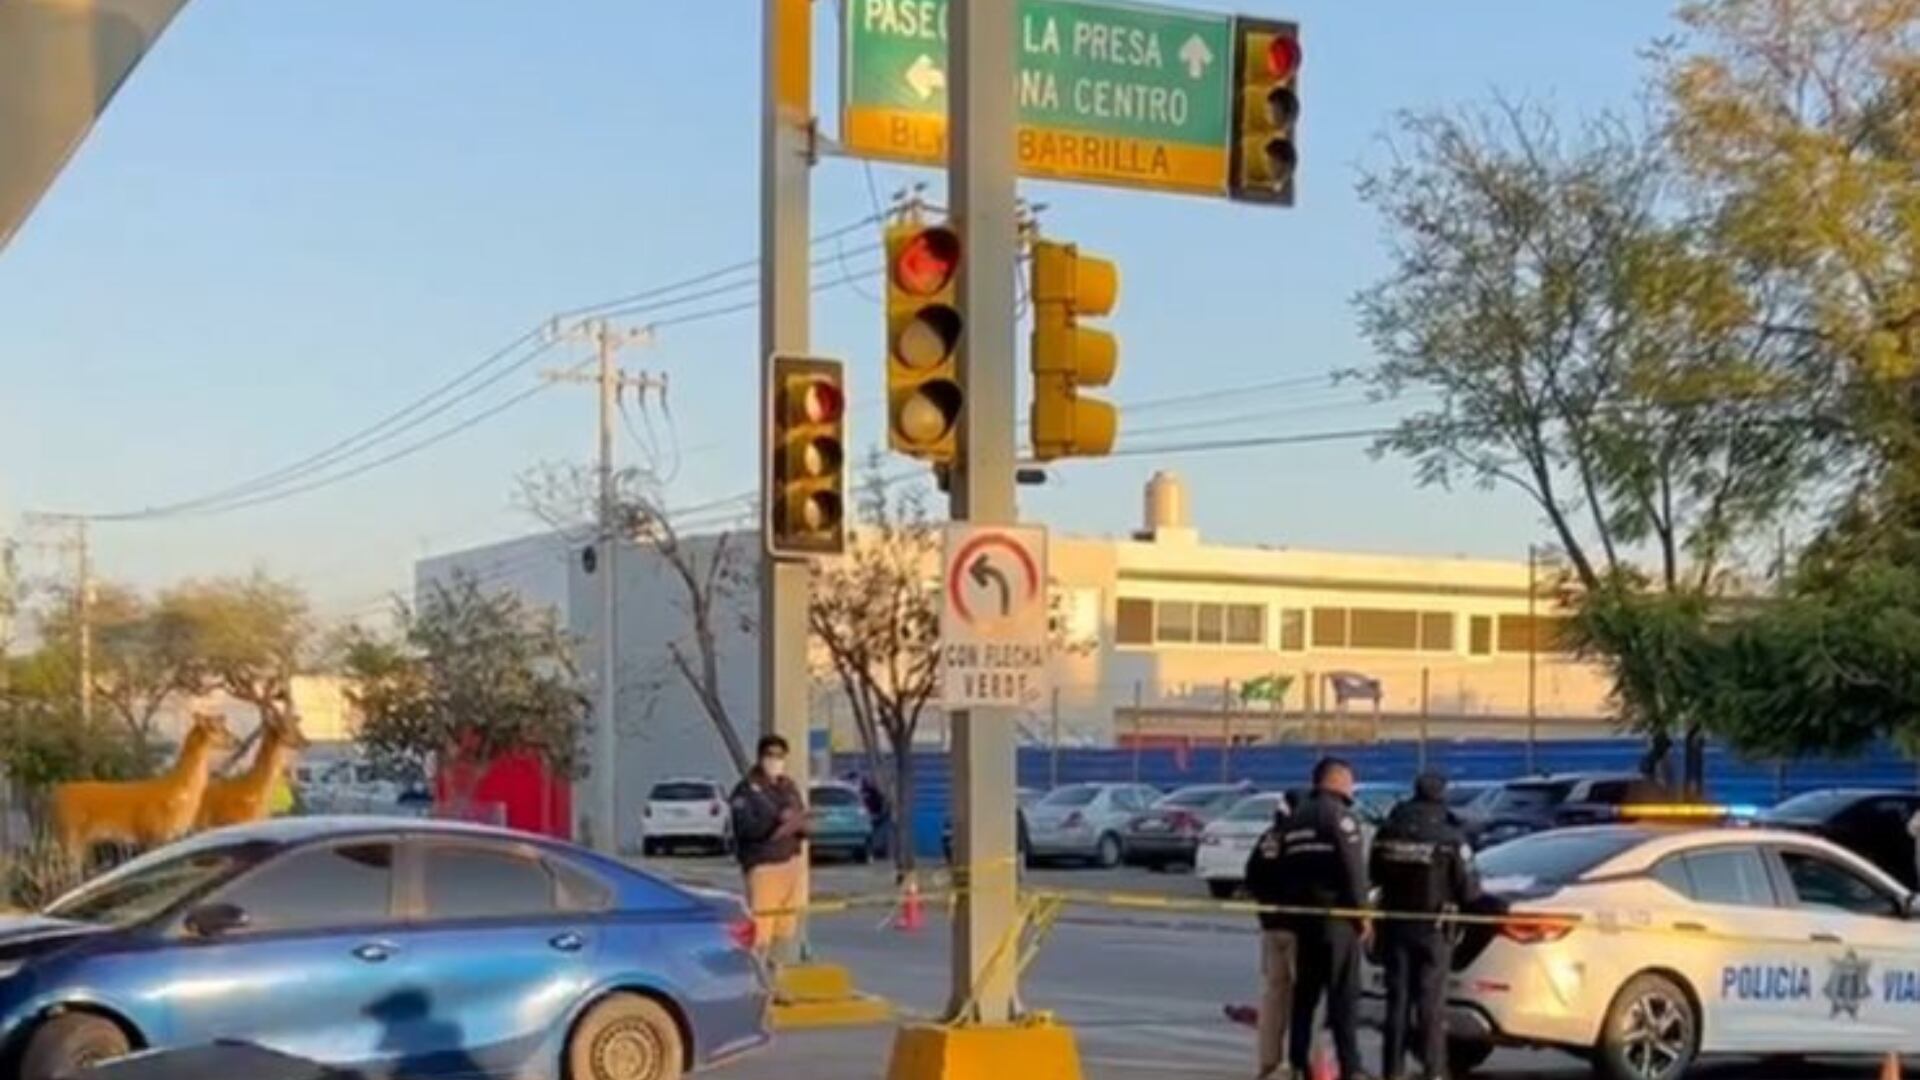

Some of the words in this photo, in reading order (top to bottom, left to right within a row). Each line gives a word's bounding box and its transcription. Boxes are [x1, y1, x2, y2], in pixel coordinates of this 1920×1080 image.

[1023, 14, 1060, 55] LA
[1073, 20, 1163, 68] PRESA
[1074, 76, 1188, 126] CENTRO
[1017, 128, 1170, 175] BARRILLA
[946, 643, 977, 667] CON
[984, 643, 1043, 668] FLECHA
